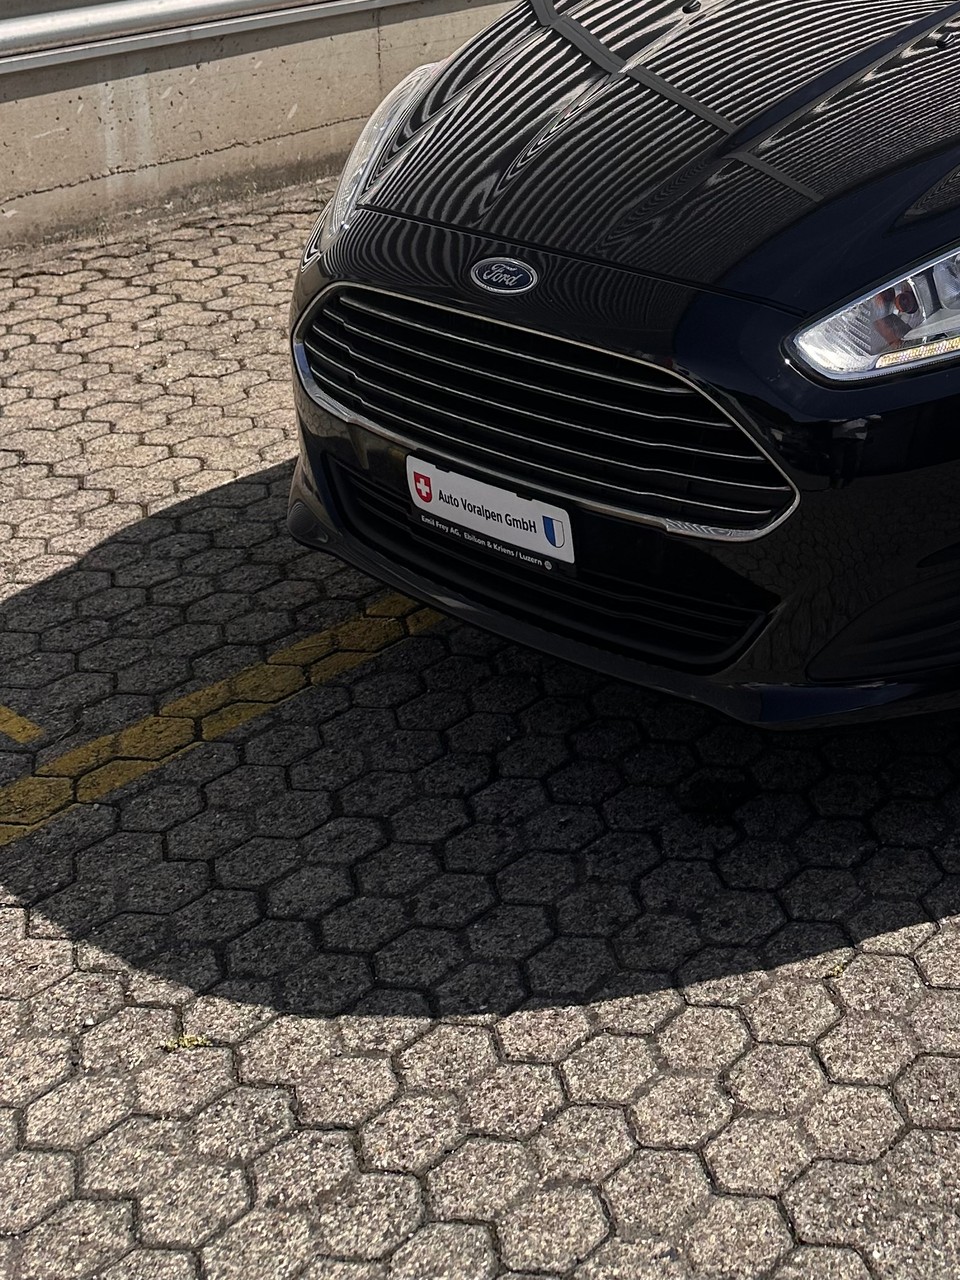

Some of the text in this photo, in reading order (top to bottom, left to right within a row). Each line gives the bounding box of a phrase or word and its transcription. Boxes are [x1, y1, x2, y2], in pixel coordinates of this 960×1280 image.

[482, 263, 523, 286] Ford
[438, 489, 537, 534] Auto Voralpen GmbH
[421, 514, 435, 526] Emil
[435, 520, 449, 533] Frey
[487, 540, 493, 549] &
[493, 543, 515, 557] Kriens
[519, 551, 543, 566] Luzern
